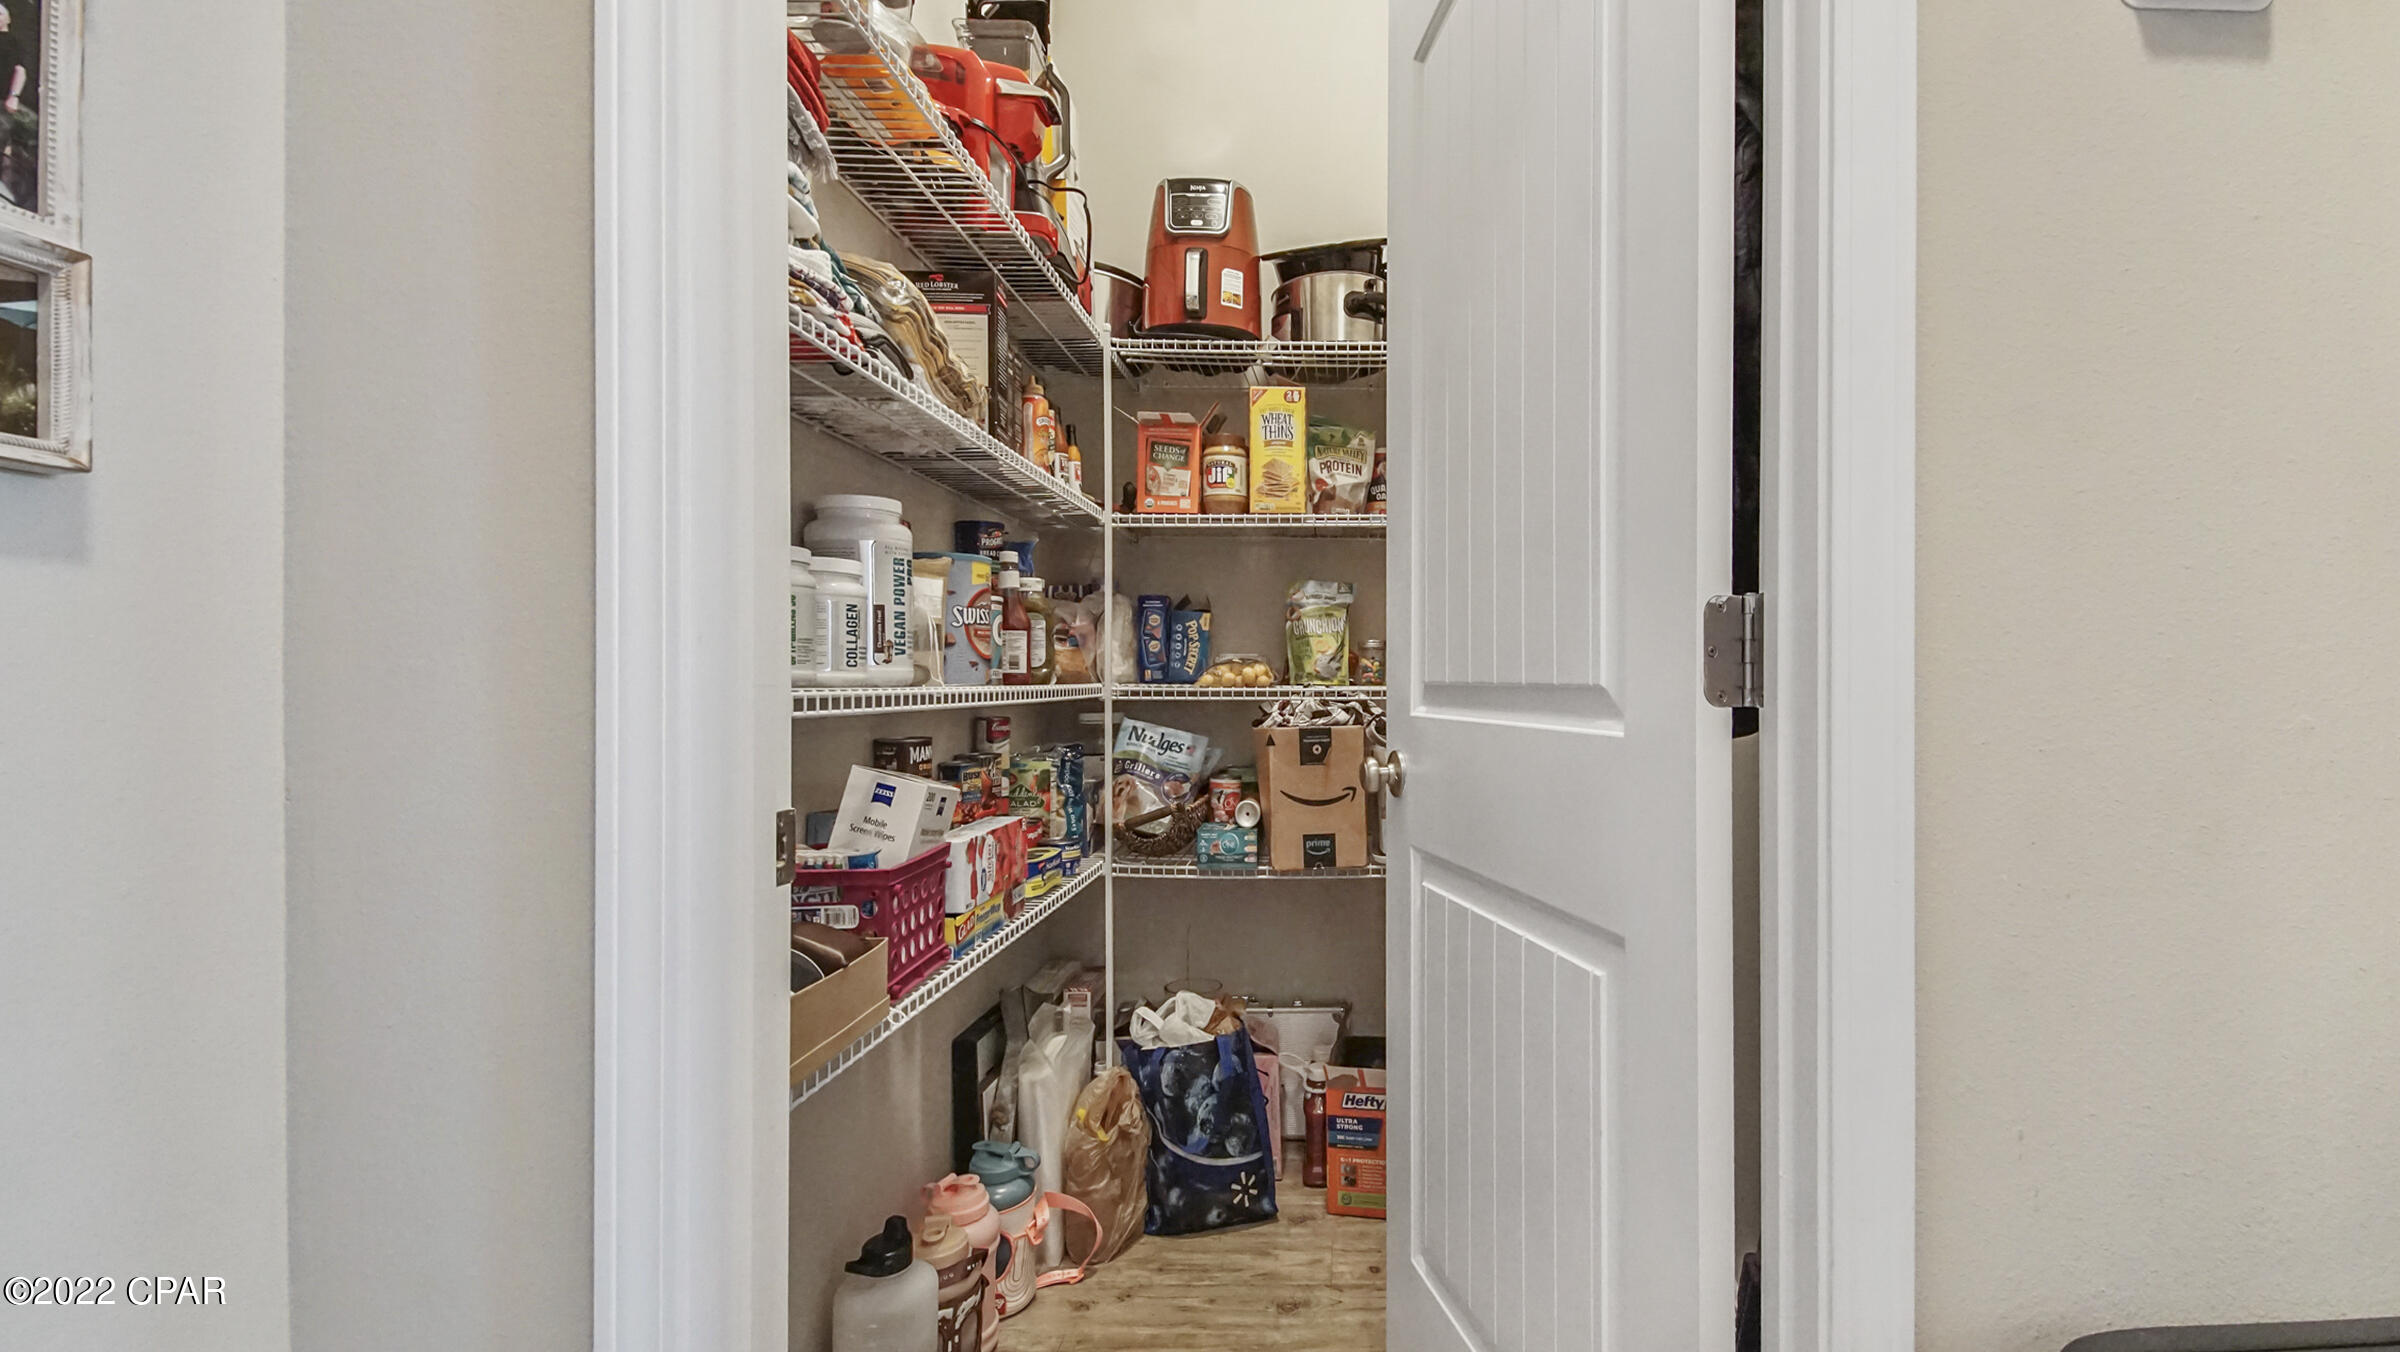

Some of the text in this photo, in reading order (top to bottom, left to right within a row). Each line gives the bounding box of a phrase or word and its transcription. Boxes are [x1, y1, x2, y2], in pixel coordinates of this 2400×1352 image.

[930, 281, 959, 289] LOBSTER
[1261, 412, 1293, 425] WHEAT
[1262, 424, 1294, 440] THINS
[1153, 444, 1180, 453] SEEDS
[1317, 447, 1366, 460] NATURE VALLEY
[1152, 452, 1185, 462] CHANGE
[1319, 459, 1363, 477] PROTEIN
[892, 557, 906, 606] POWER
[952, 605, 990, 628] SWISS
[845, 603, 858, 667] COLLAGEN
[893, 610, 906, 656] VEGAN
[1183, 619, 1201, 676] POP SECRET
[1127, 725, 1185, 756] Nudges
[1124, 760, 1161, 779] Grillers
[874, 787, 896, 798] ZEISS
[849, 823, 873, 835] Screen
[863, 816, 888, 829] Mobile
[1306, 838, 1331, 848] prime
[958, 911, 975, 940] GLAD
[1344, 1094, 1385, 1110] Hefty
[1336, 1117, 1358, 1125] ULTRA
[1336, 1123, 1364, 1131] STRONG
